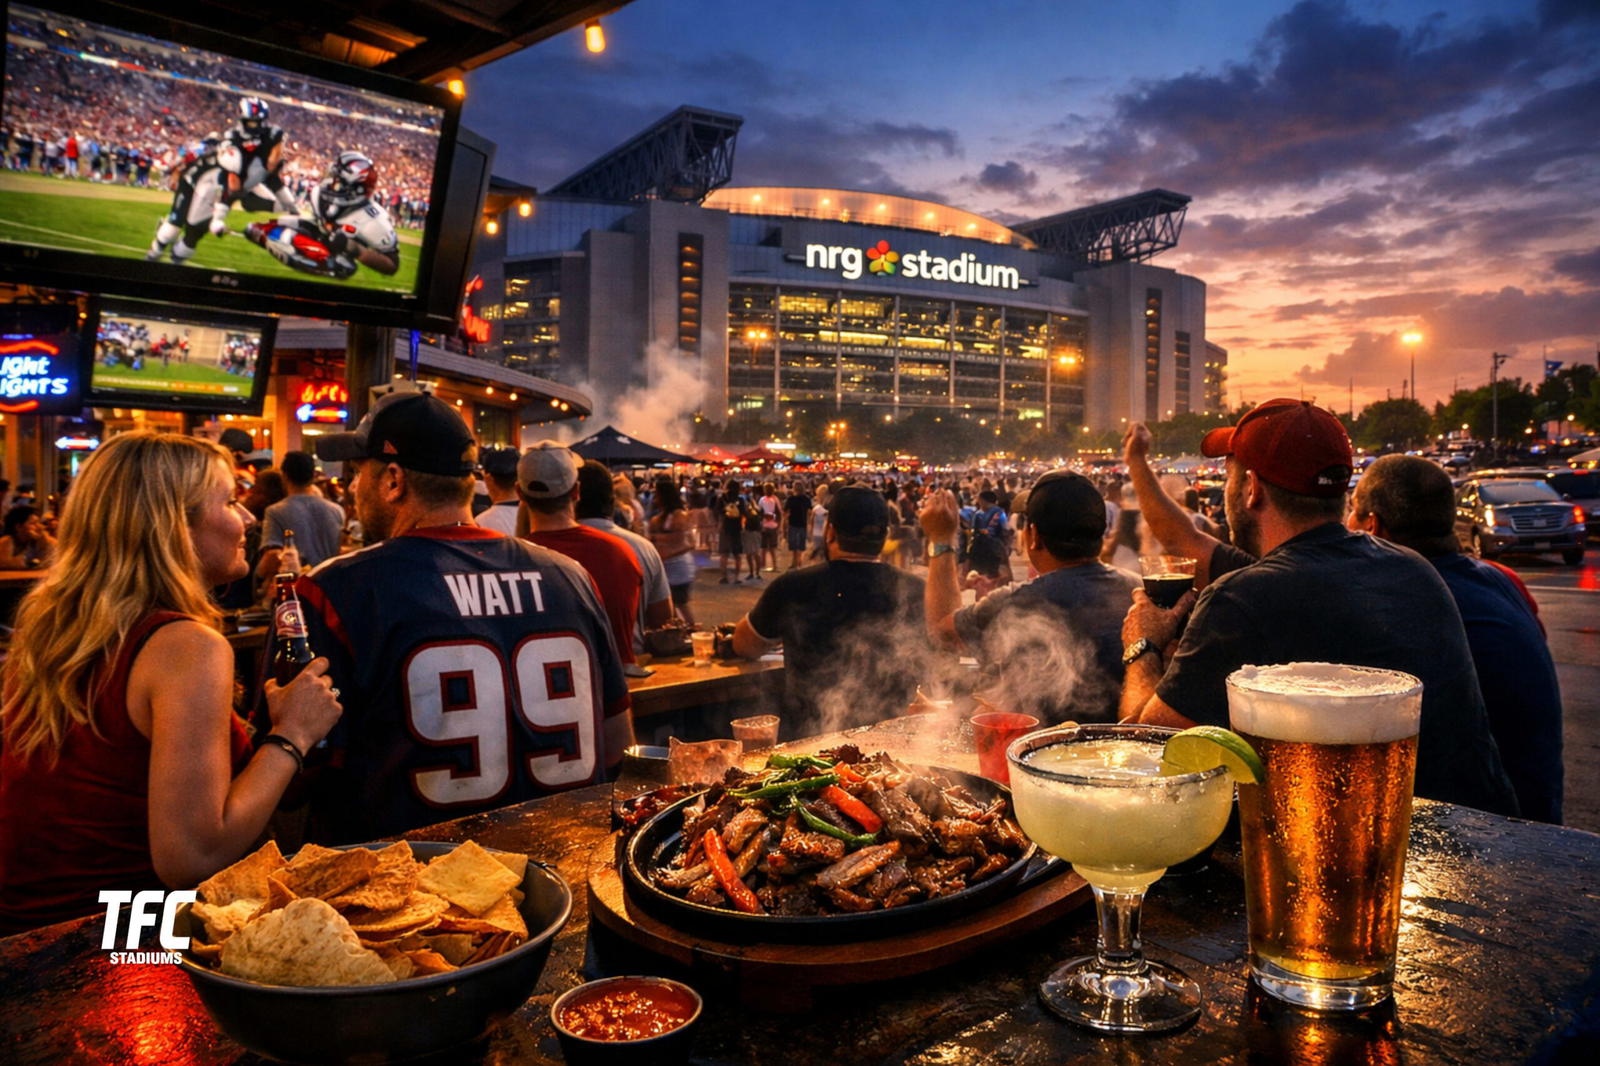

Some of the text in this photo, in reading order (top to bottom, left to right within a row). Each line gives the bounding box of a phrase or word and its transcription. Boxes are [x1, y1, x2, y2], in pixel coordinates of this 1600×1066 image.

[806, 244, 1019, 289] nrg stadium
[443, 571, 545, 617] WATT
[403, 631, 597, 808] 99
